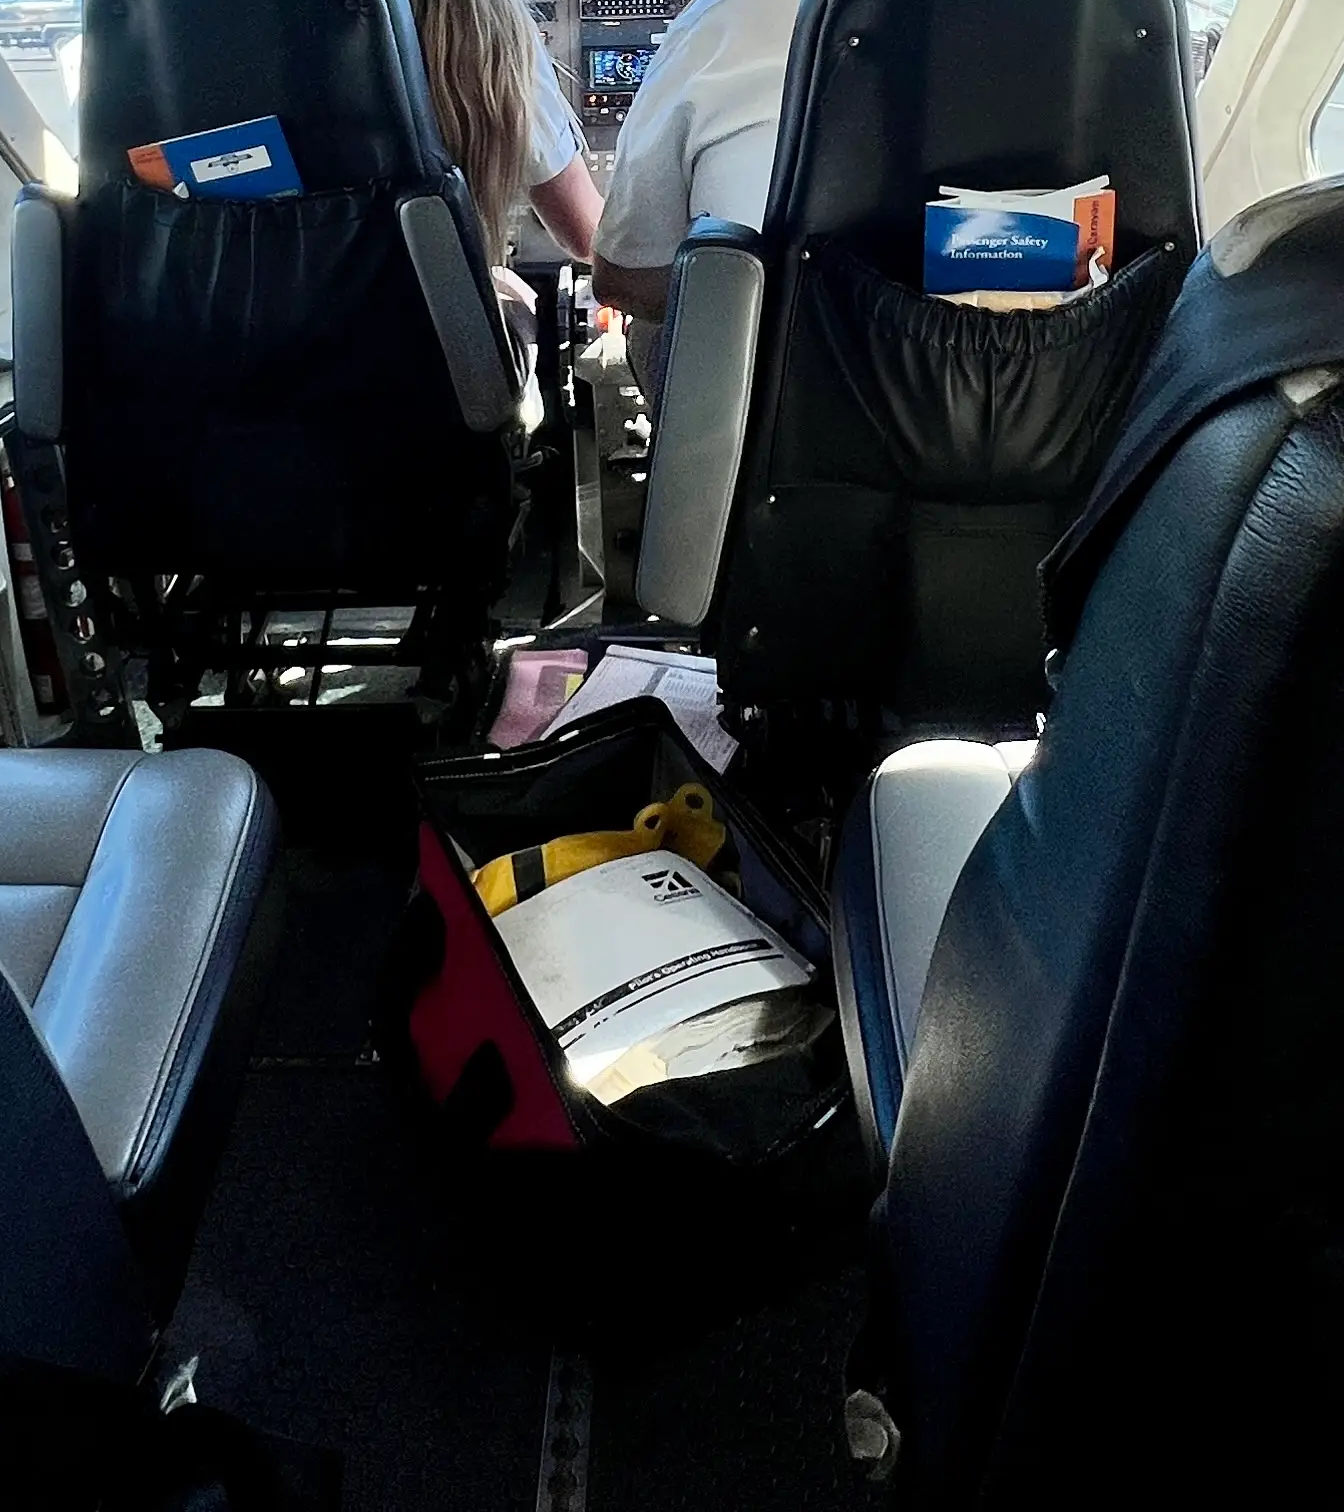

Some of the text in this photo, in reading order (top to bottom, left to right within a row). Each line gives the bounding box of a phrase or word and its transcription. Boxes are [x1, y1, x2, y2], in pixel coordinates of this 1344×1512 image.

[1010, 235, 1049, 250] Safety
[949, 248, 1024, 260] Information
[661, 953, 712, 975] Operating
